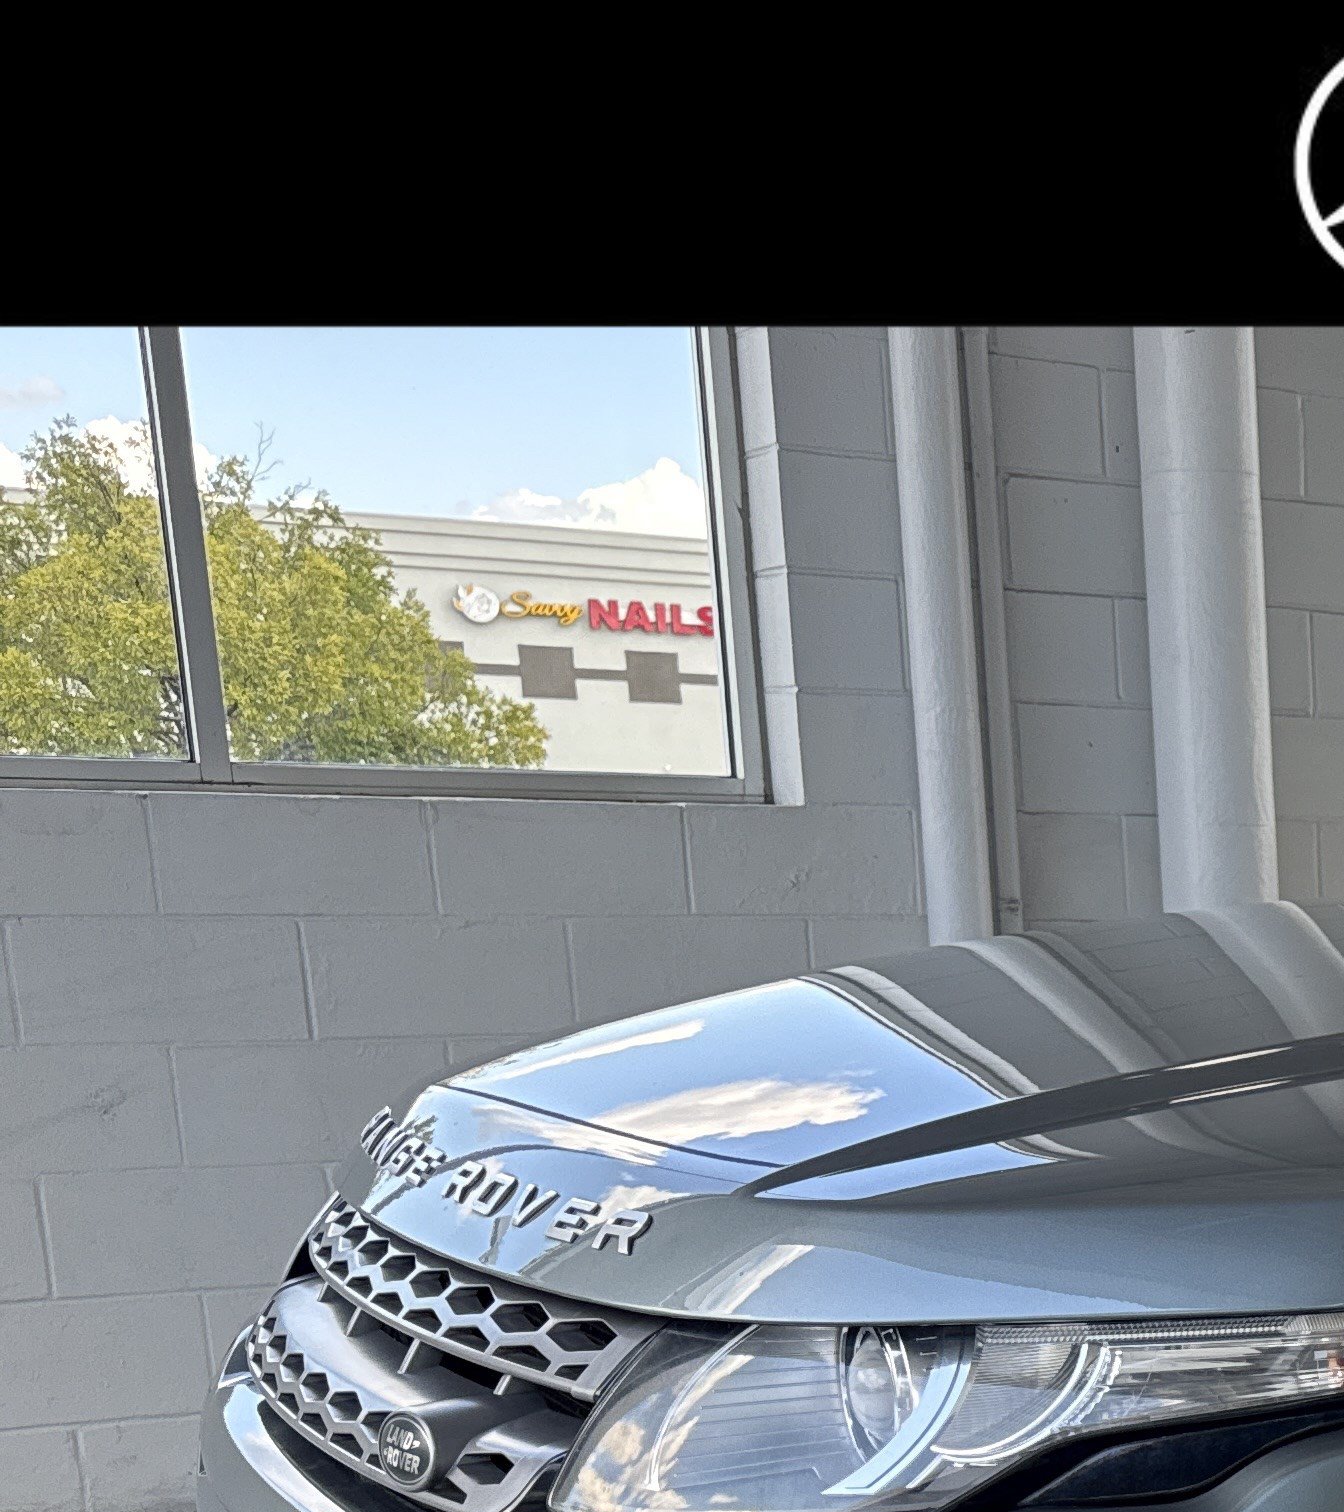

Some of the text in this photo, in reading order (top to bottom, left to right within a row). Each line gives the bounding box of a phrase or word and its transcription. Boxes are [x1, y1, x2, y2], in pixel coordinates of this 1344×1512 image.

[501, 591, 583, 626] Savvy
[441, 1160, 654, 1257] ROVER
[385, 1423, 415, 1451] LAND
[386, 1445, 421, 1475] ROVER
